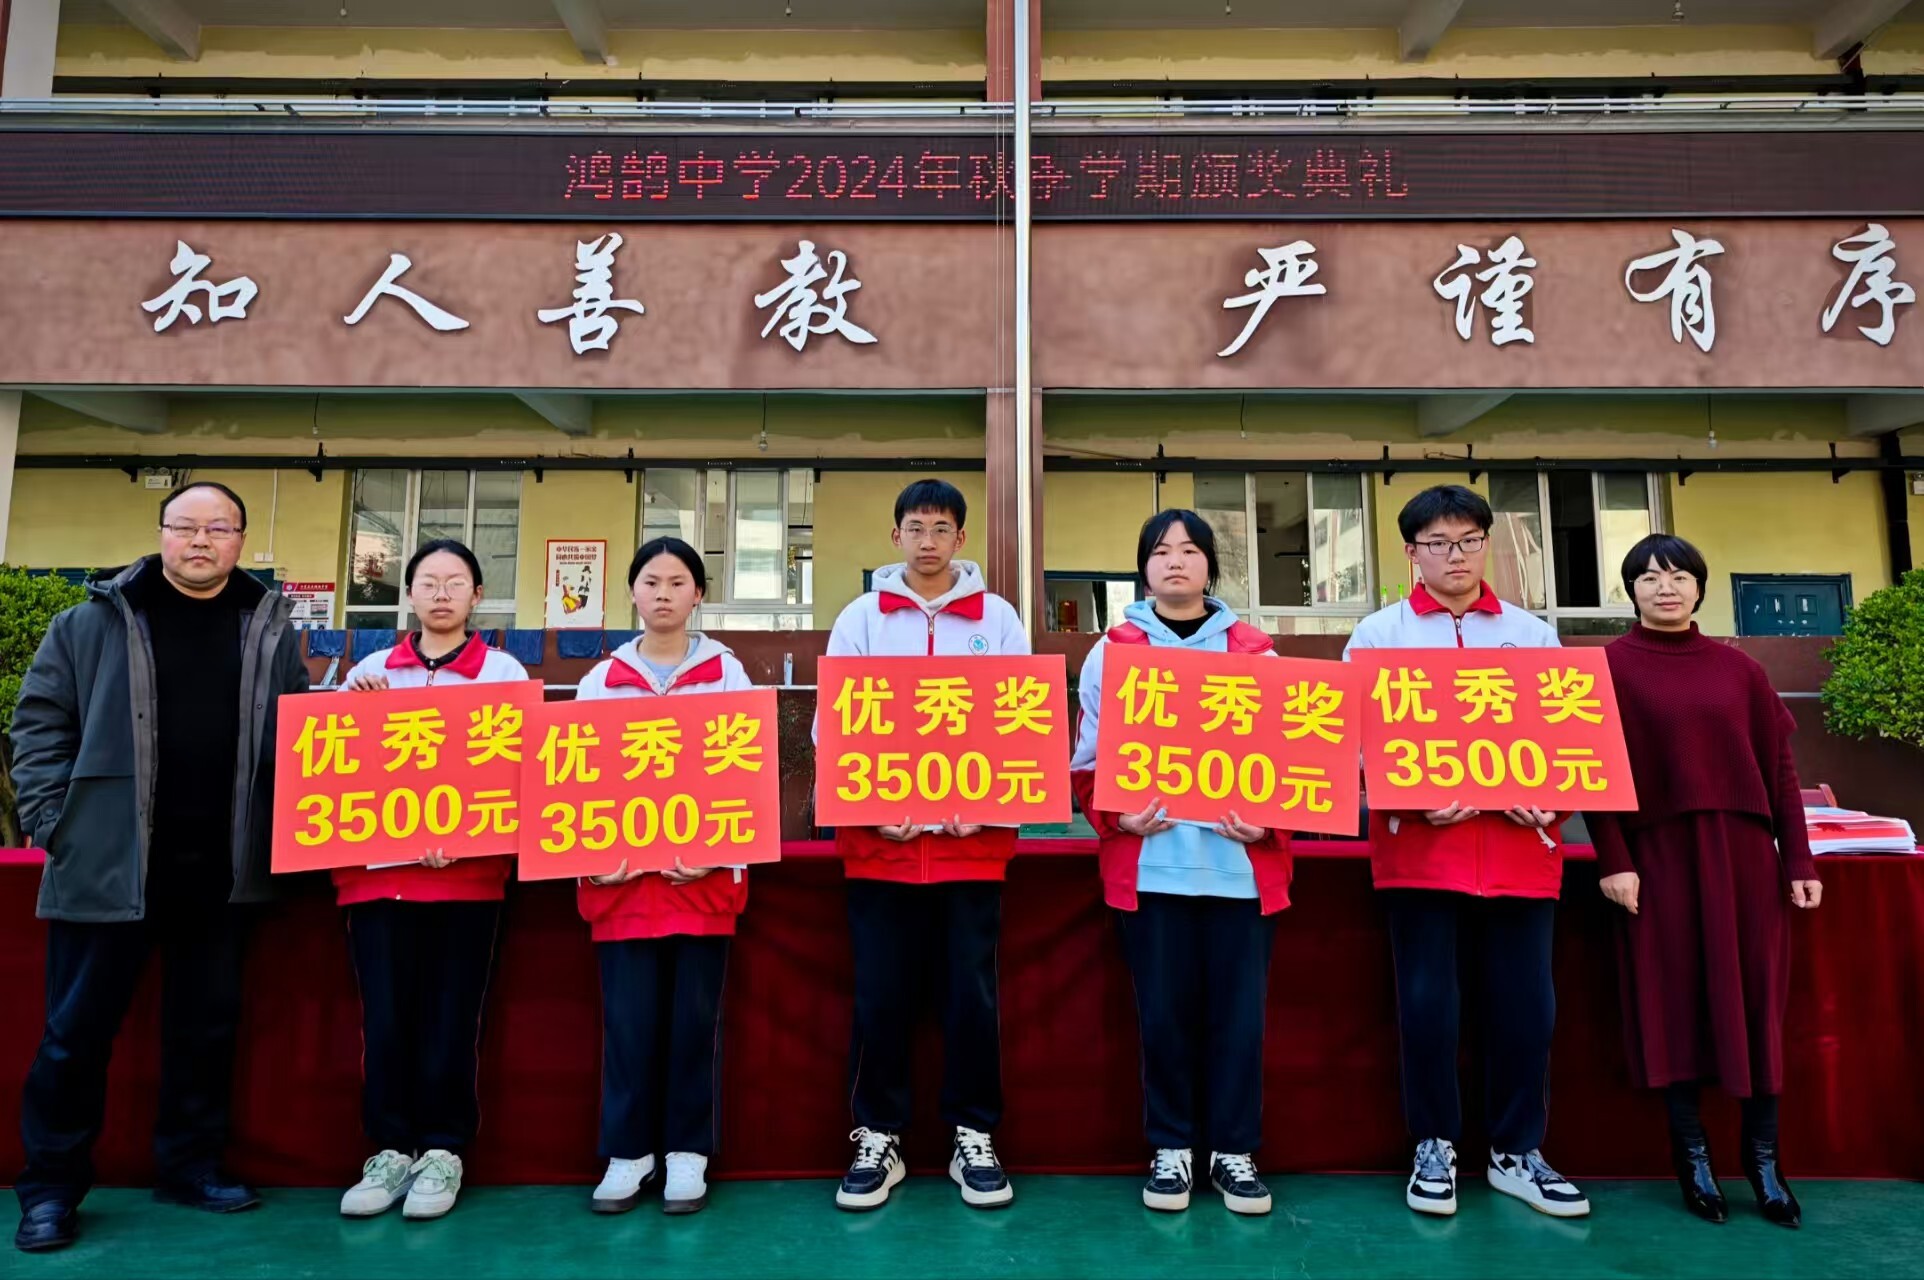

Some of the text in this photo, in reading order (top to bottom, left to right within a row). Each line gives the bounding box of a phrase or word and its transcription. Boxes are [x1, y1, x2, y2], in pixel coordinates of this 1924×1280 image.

[564, 150, 1409, 200] 鸿鹄中学2024年秋季学期颁奖典礼
[142, 224, 1916, 356] 知人善教 严谨有序
[833, 676, 1053, 735] 优秀奖
[1117, 667, 1344, 743] 优秀奖
[1372, 668, 1604, 723] 优秀奖
[293, 704, 524, 777] 优秀奖
[537, 713, 763, 785] 优秀奖
[1384, 740, 1607, 791] 3500元
[837, 752, 1046, 804] 3500元
[1116, 742, 1332, 812] 3500元
[296, 785, 518, 845] 3500元
[541, 794, 755, 852] 3500元
